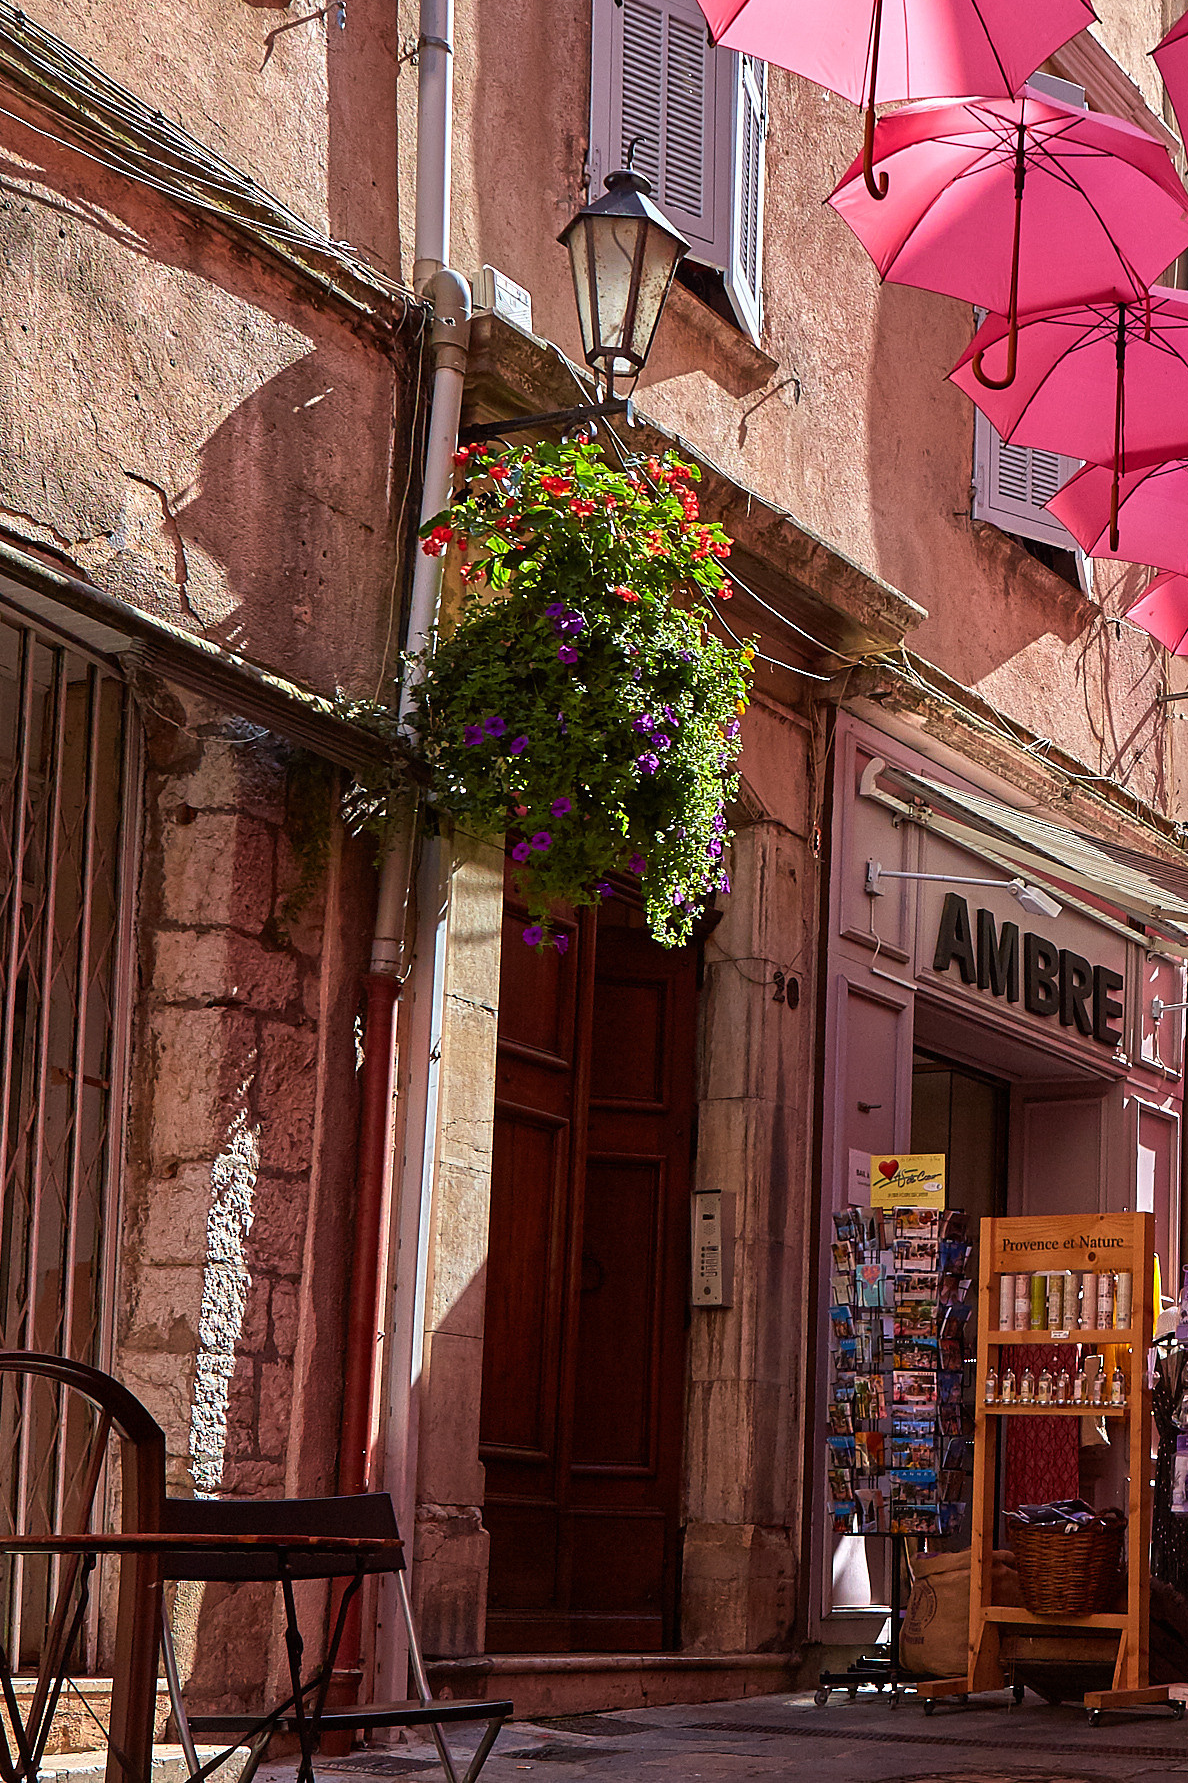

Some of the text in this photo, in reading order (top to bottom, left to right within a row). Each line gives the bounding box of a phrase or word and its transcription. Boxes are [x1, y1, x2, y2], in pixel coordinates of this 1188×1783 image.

[933, 892, 1124, 1047] AMBRE
[1002, 1235, 1124, 1251] Provence et Nature
